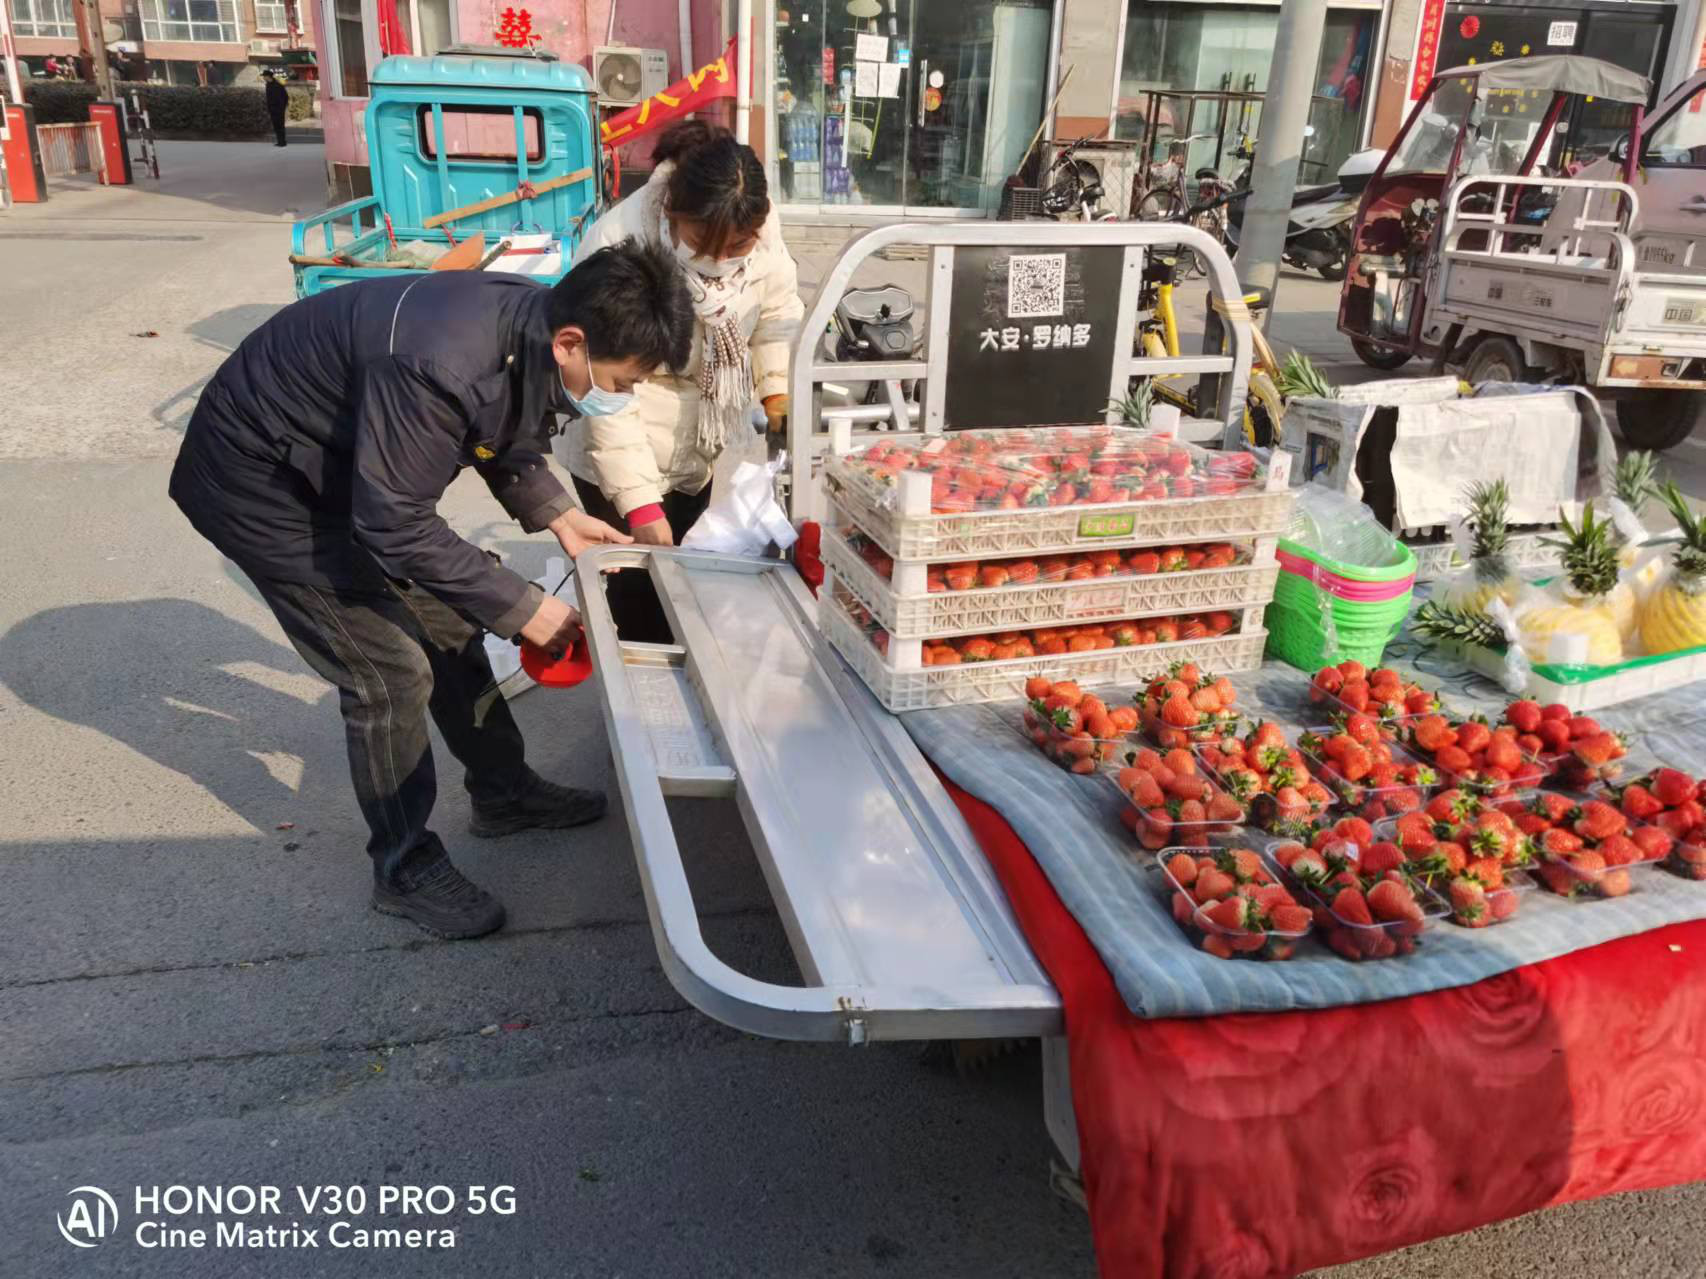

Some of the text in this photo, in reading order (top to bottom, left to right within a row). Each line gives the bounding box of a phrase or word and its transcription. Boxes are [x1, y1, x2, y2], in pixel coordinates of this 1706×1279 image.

[979, 323, 1092, 352] 大安·罗纳多
